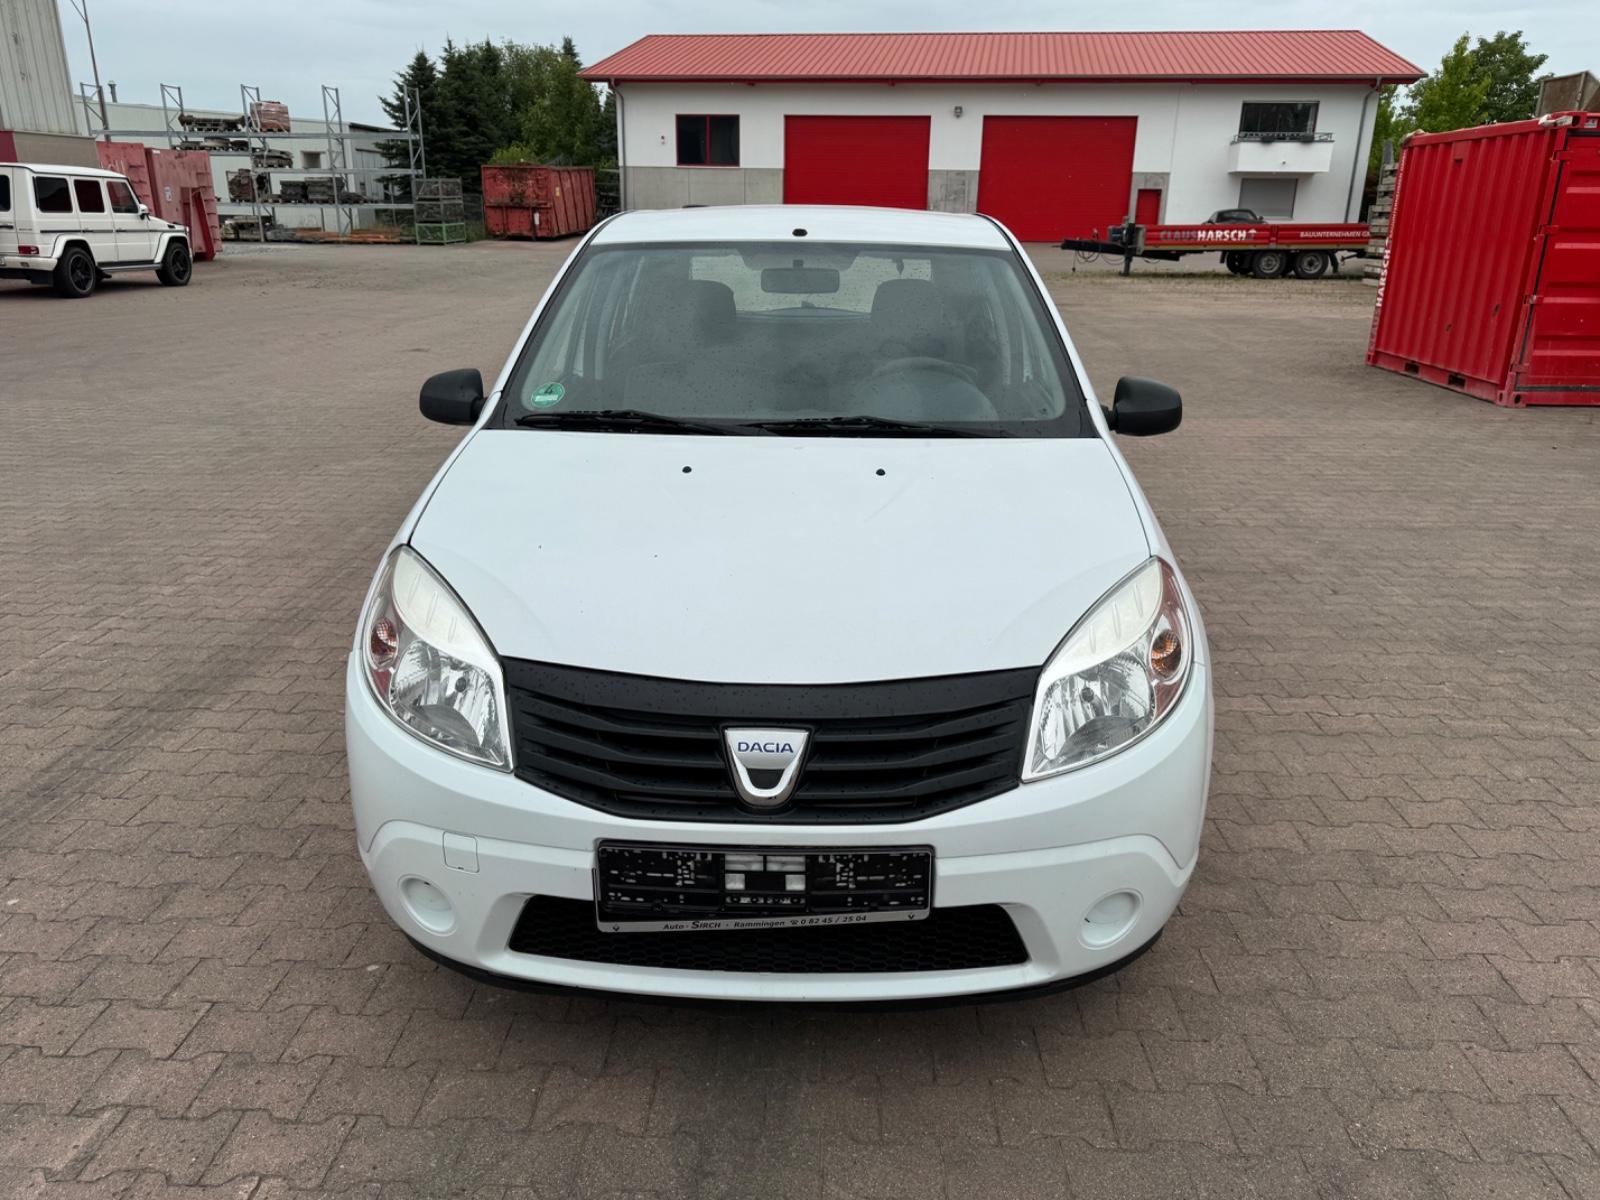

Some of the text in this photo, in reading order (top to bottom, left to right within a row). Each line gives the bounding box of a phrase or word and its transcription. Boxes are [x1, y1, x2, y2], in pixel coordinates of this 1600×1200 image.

[543, 384, 554, 395] 4
[738, 742, 794, 753] DACIA
[734, 919, 785, 929] Rammingen
